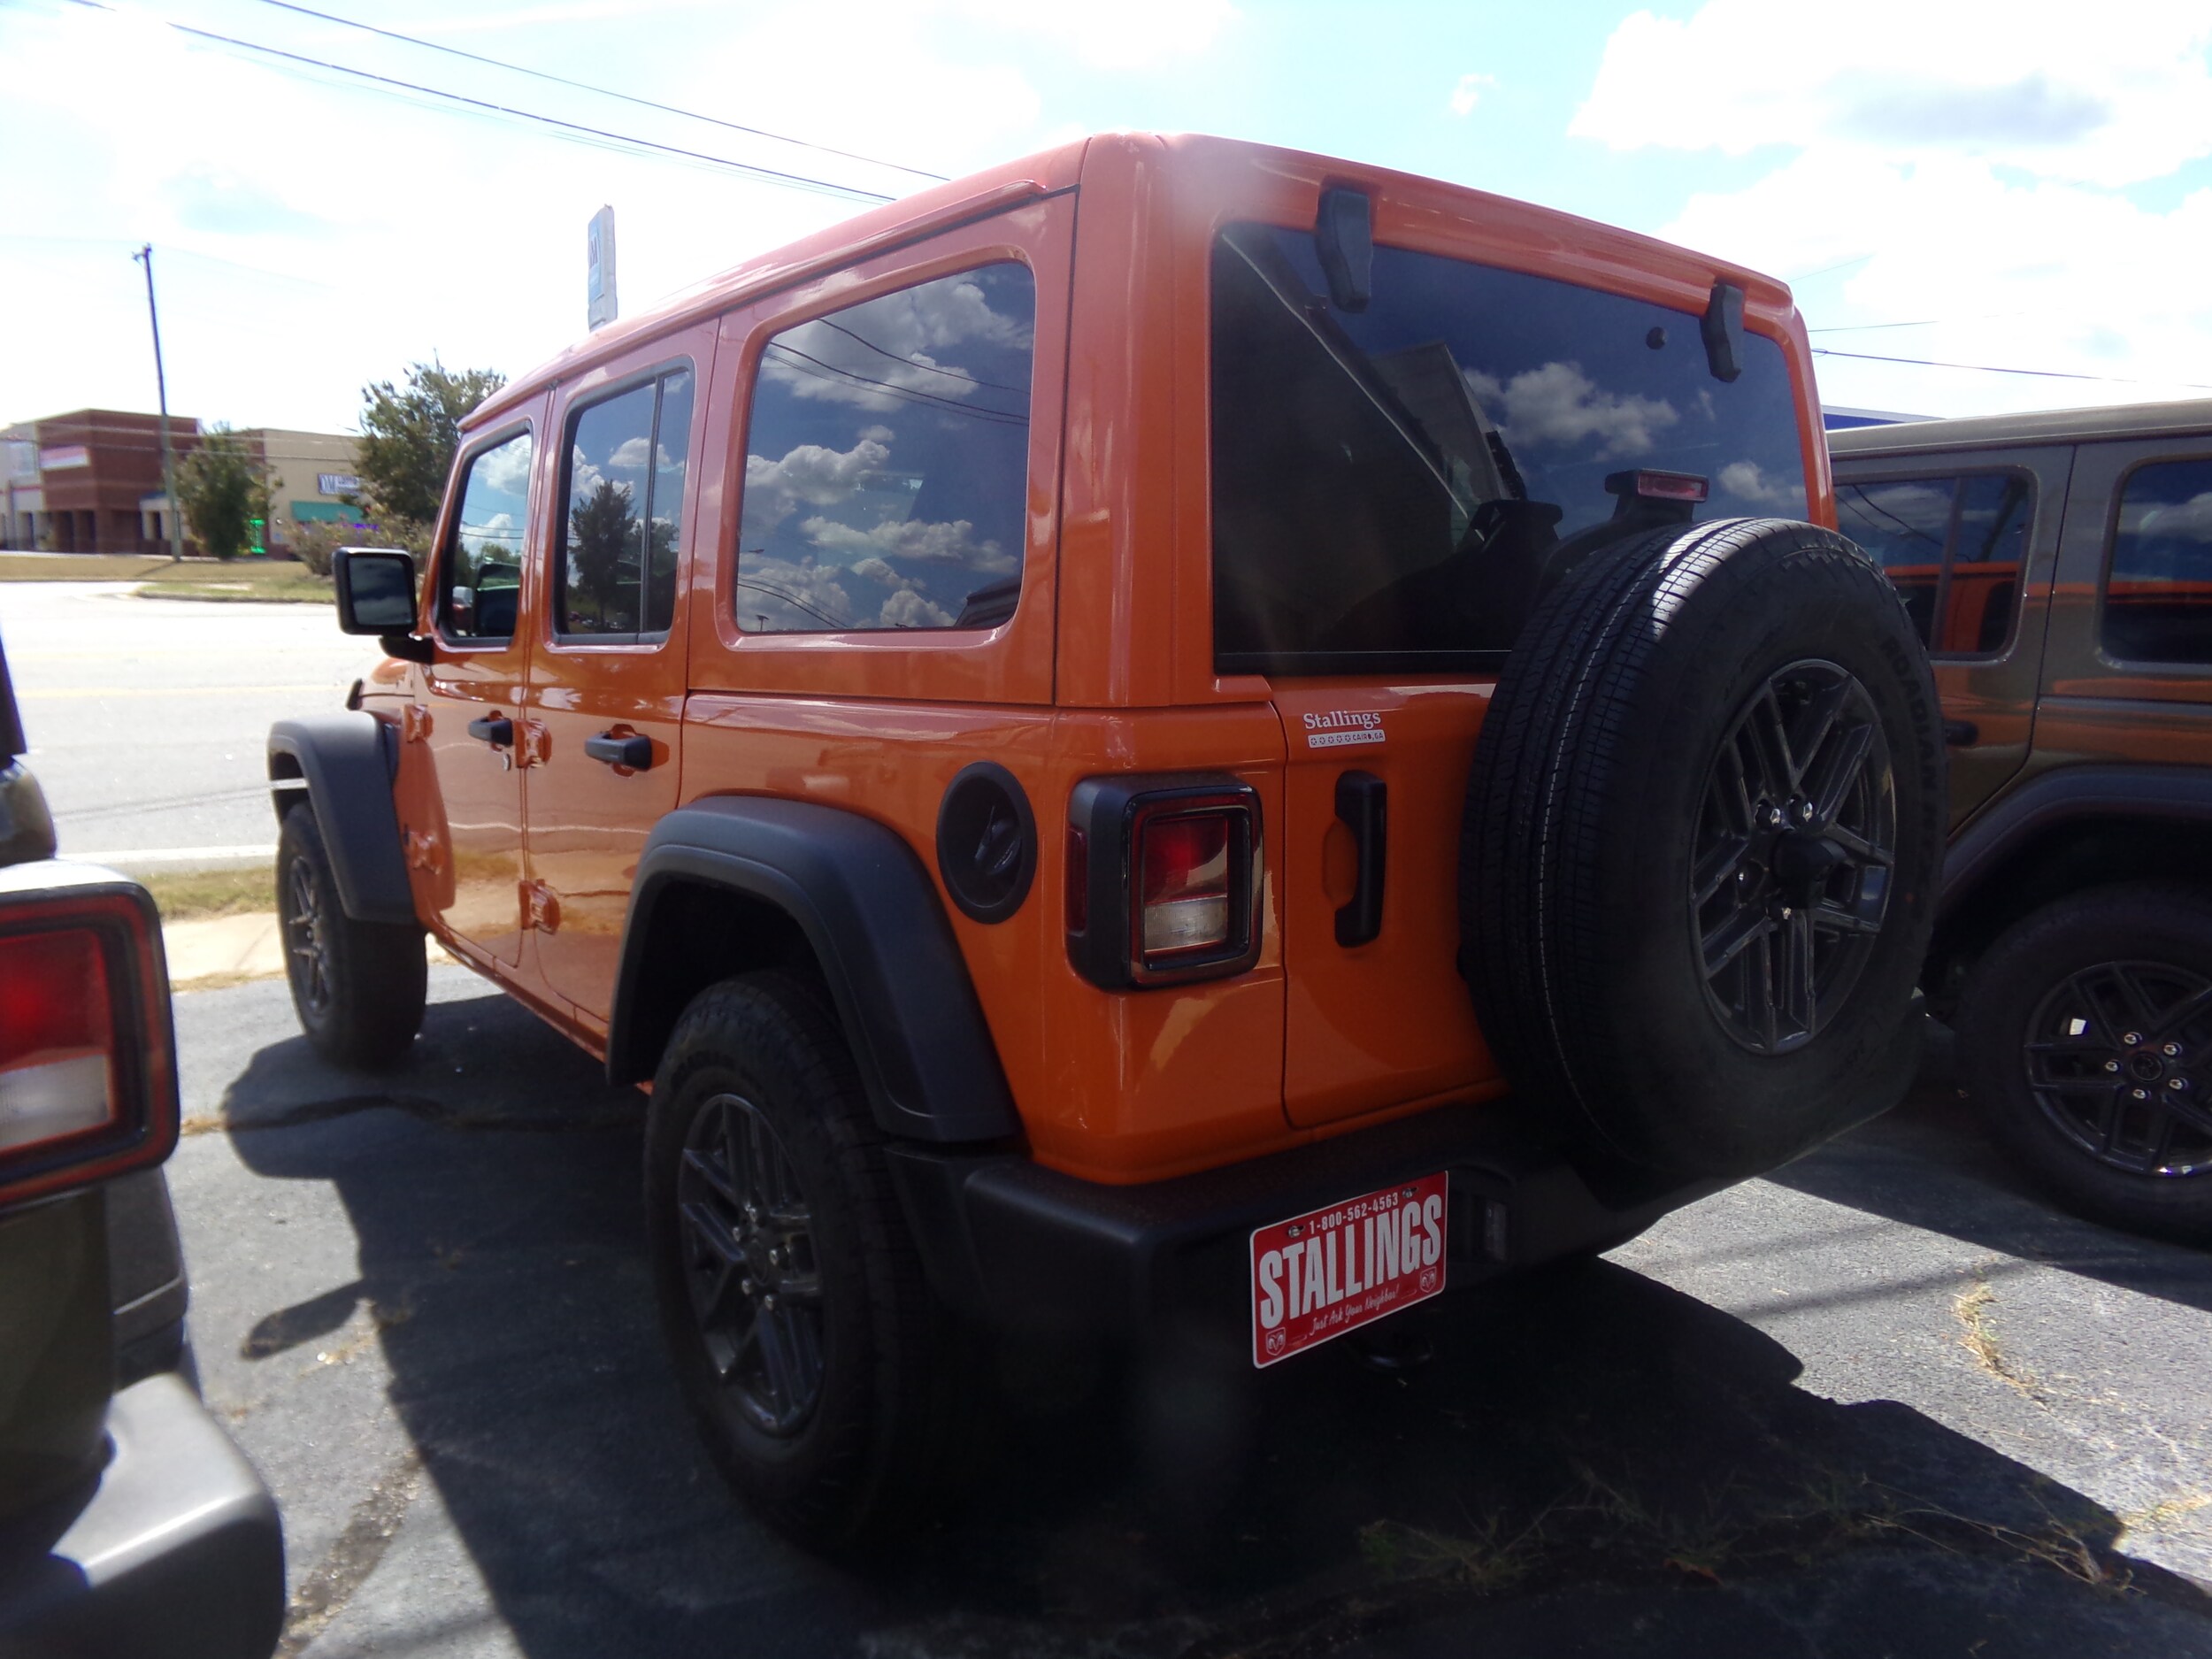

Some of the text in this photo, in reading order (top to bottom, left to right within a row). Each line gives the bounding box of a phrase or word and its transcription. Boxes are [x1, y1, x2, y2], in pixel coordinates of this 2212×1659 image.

[1302, 710, 1381, 729] Stallings
[1310, 1192, 1398, 1234] 1-800-562-4563
[1259, 1194, 1442, 1329] STALLINGS
[1309, 1314, 1328, 1336] Just
[1328, 1307, 1343, 1325] Ask
[1344, 1304, 1363, 1324] Your
